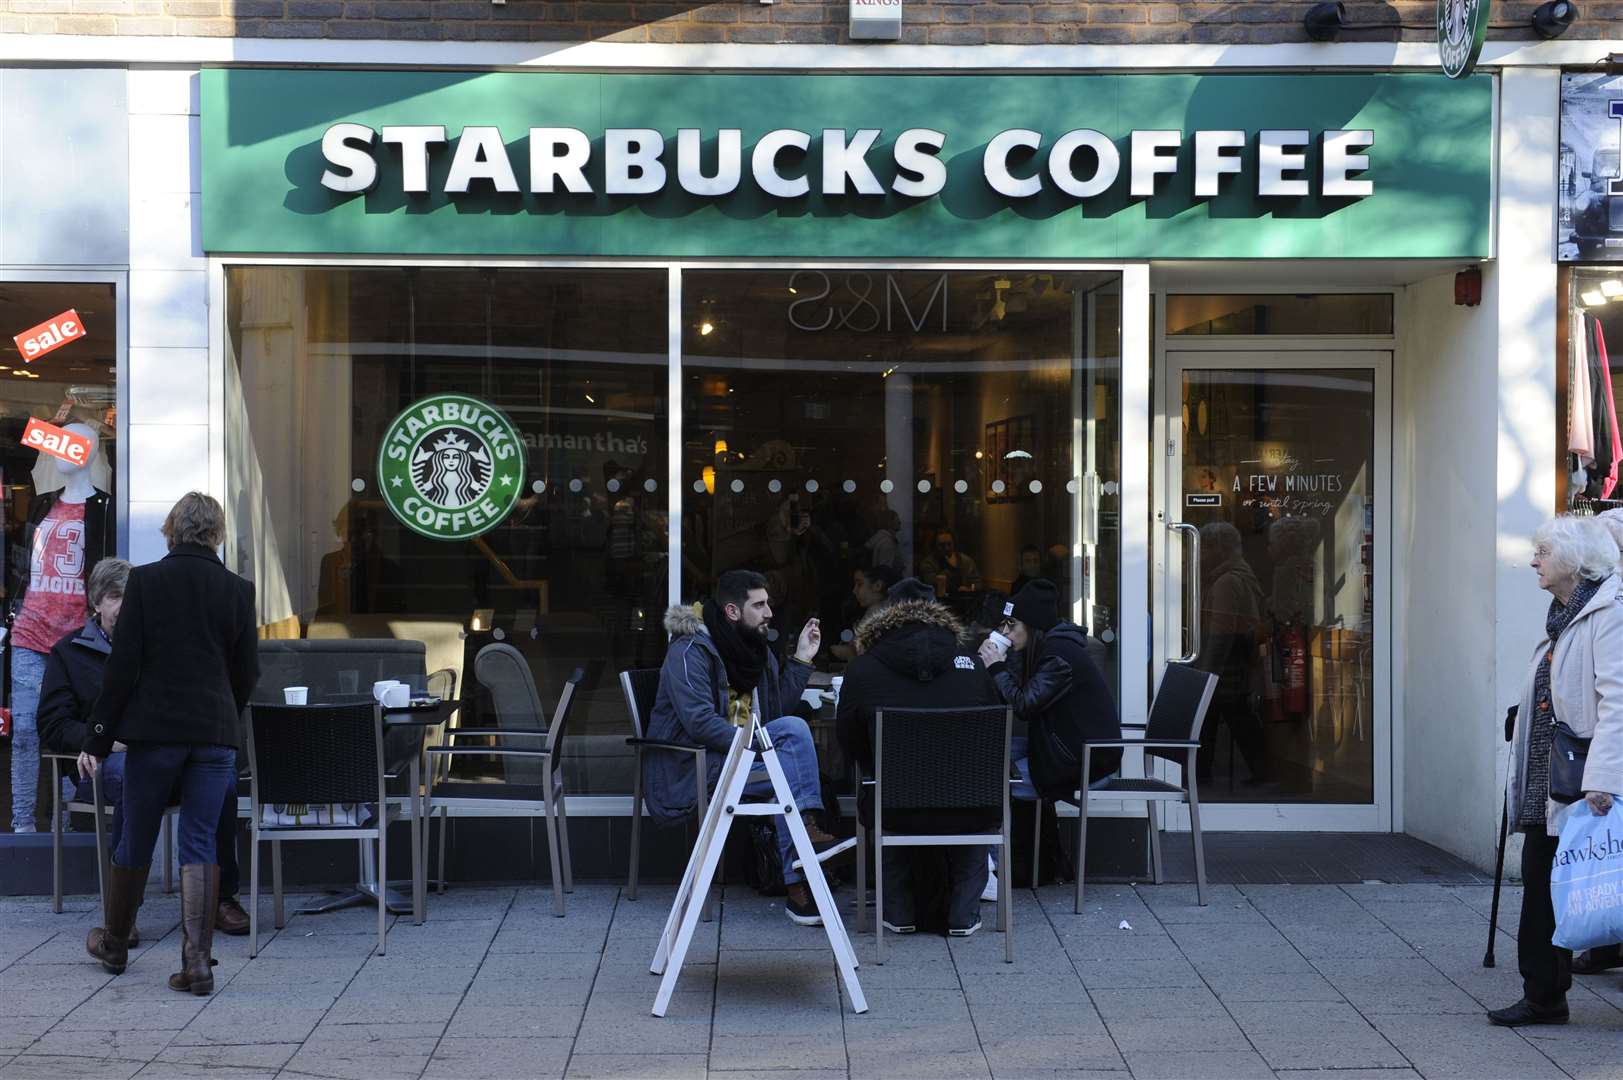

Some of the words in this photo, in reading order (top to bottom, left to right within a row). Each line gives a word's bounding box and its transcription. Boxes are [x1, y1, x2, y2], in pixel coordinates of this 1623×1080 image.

[320, 122, 946, 197] STARBUCKS
[983, 128, 1375, 197] COFFEE
[23, 320, 79, 356] sale
[27, 427, 85, 461] sale
[387, 402, 515, 461] STARBUCKS
[513, 429, 648, 455] amantha's
[1232, 475, 1241, 493] A
[1249, 475, 1277, 493] FEW
[1286, 475, 1343, 493] MINUTES
[403, 497, 500, 532] COFFEE
